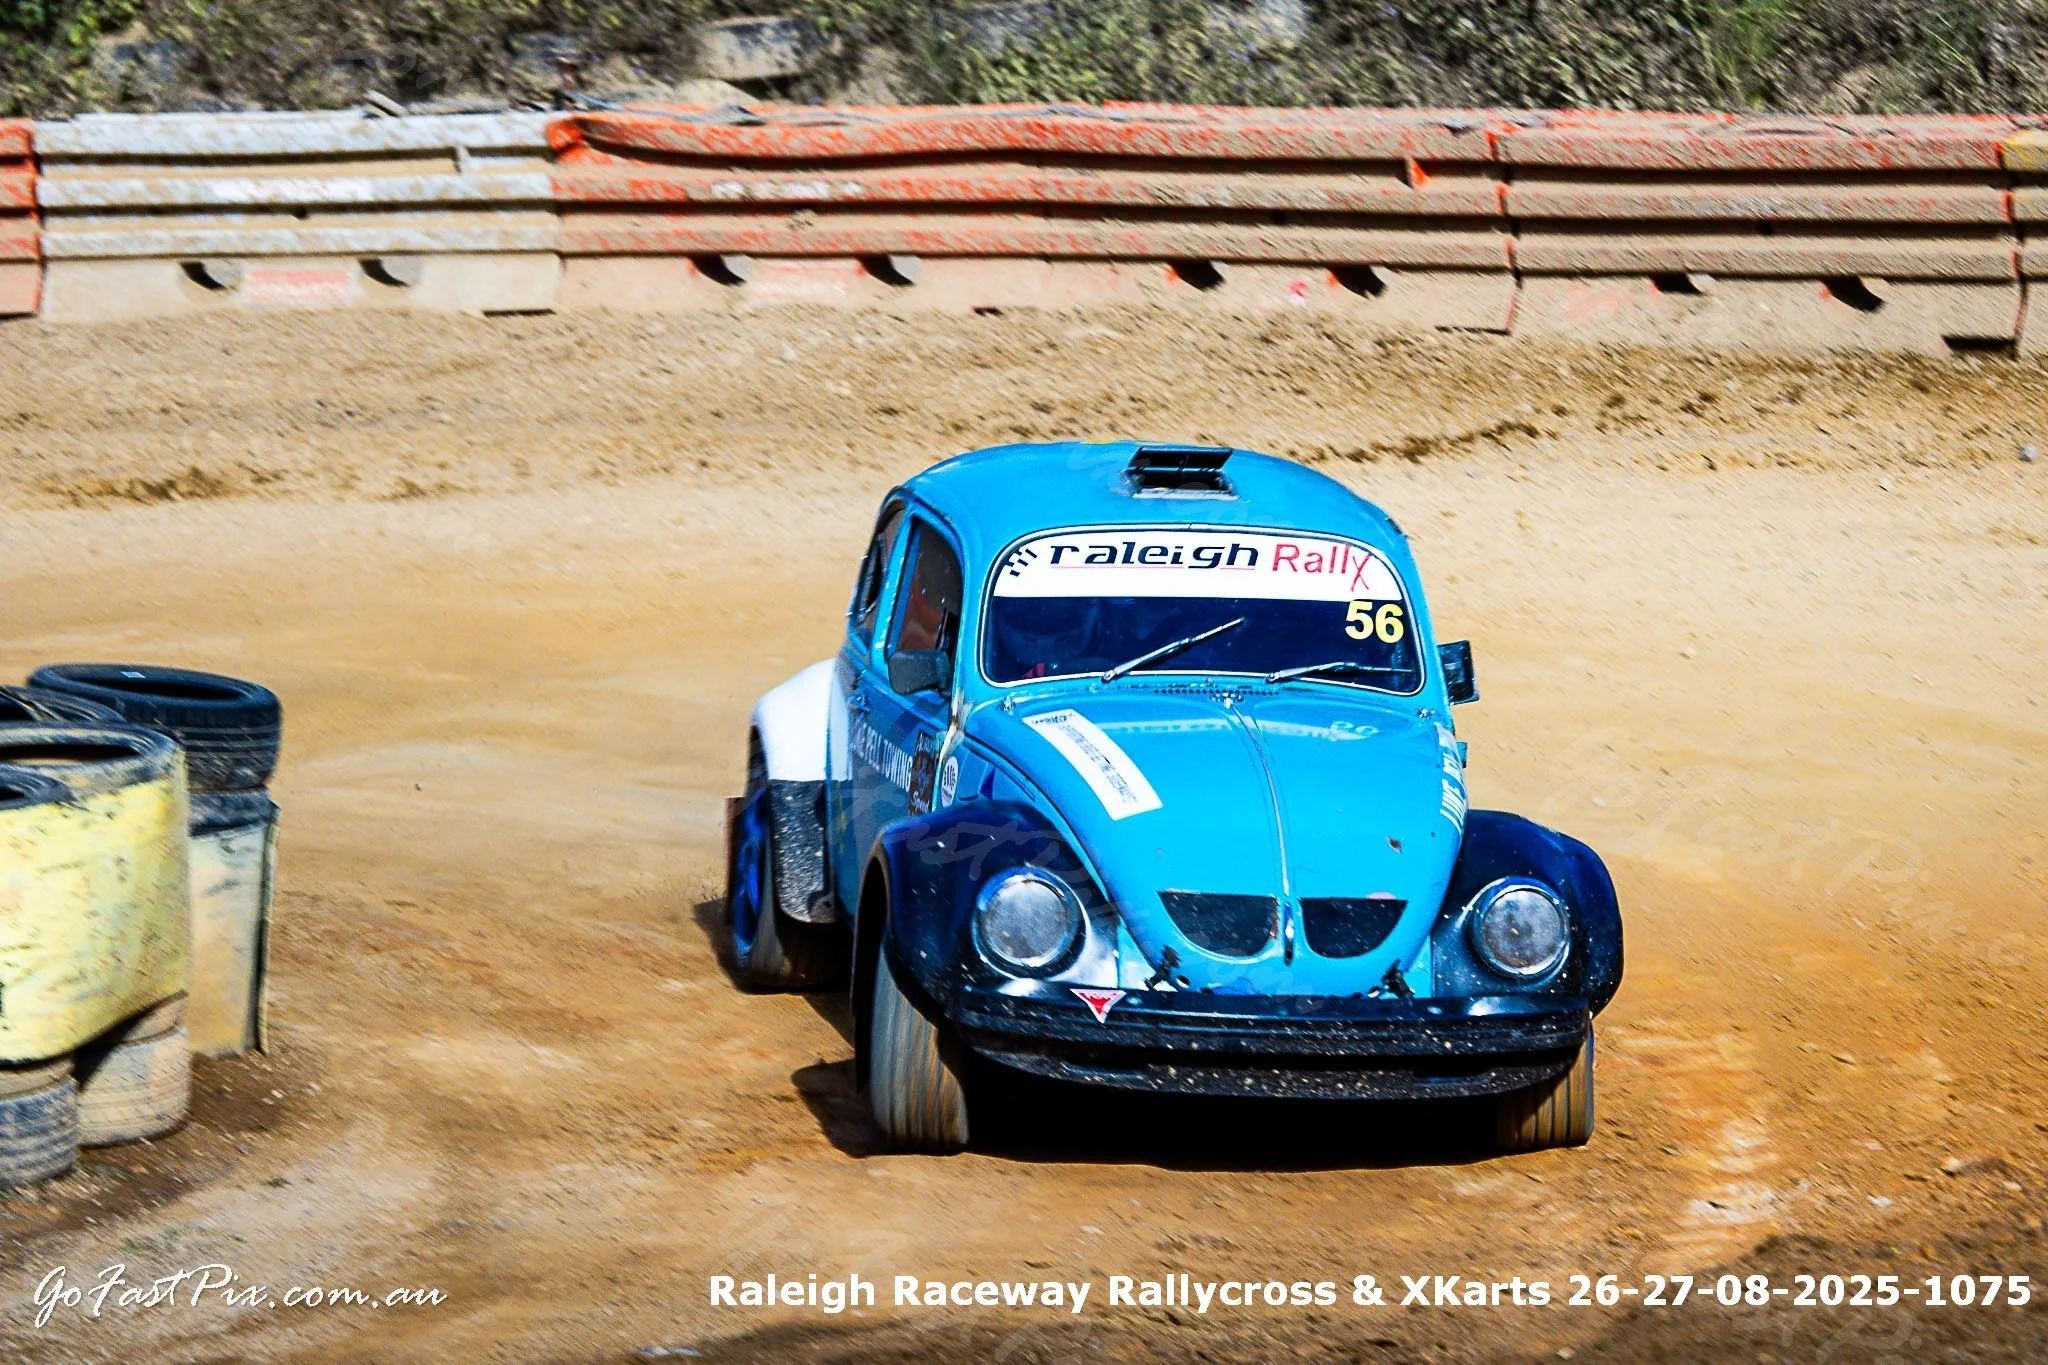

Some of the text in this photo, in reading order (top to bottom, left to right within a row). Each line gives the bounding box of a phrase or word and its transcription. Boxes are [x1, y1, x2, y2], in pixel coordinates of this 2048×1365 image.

[1049, 541, 1259, 570] raleigh
[1344, 599, 1404, 643] 56
[881, 739, 913, 792] TOWING
